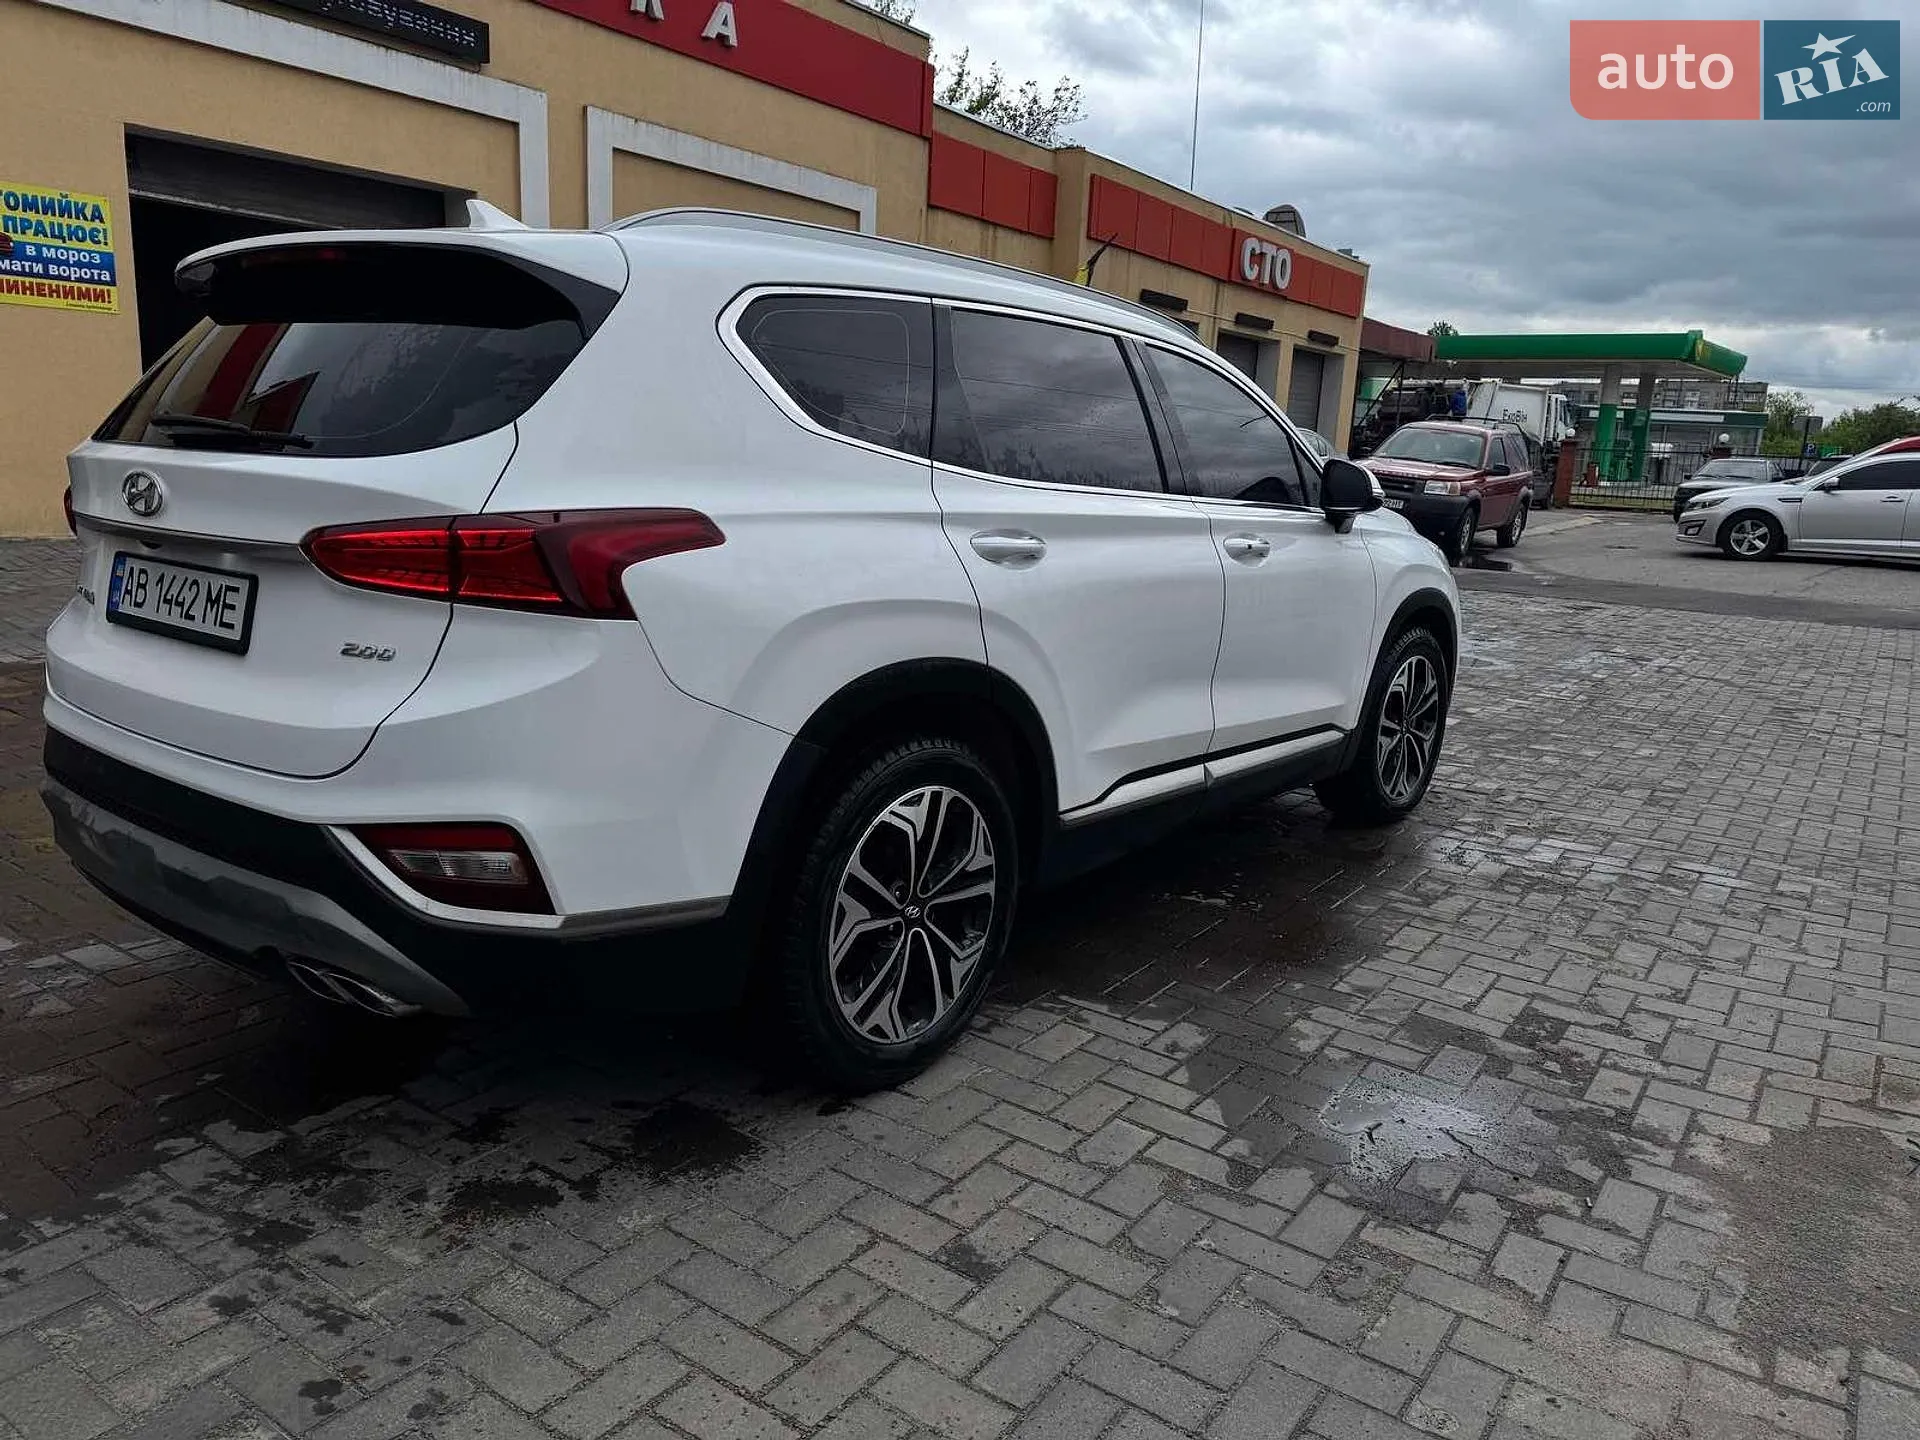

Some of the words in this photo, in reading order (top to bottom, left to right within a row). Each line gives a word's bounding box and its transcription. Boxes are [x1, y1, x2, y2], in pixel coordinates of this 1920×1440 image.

[2, 214, 108, 246] ПРАЦЮЄ!
[42, 248, 101, 264] мороз
[48, 263, 111, 281] ворота
[1241, 237, 1292, 290] СТО
[121, 566, 149, 609] AB
[155, 572, 201, 622] 1442
[201, 581, 241, 630] ME
